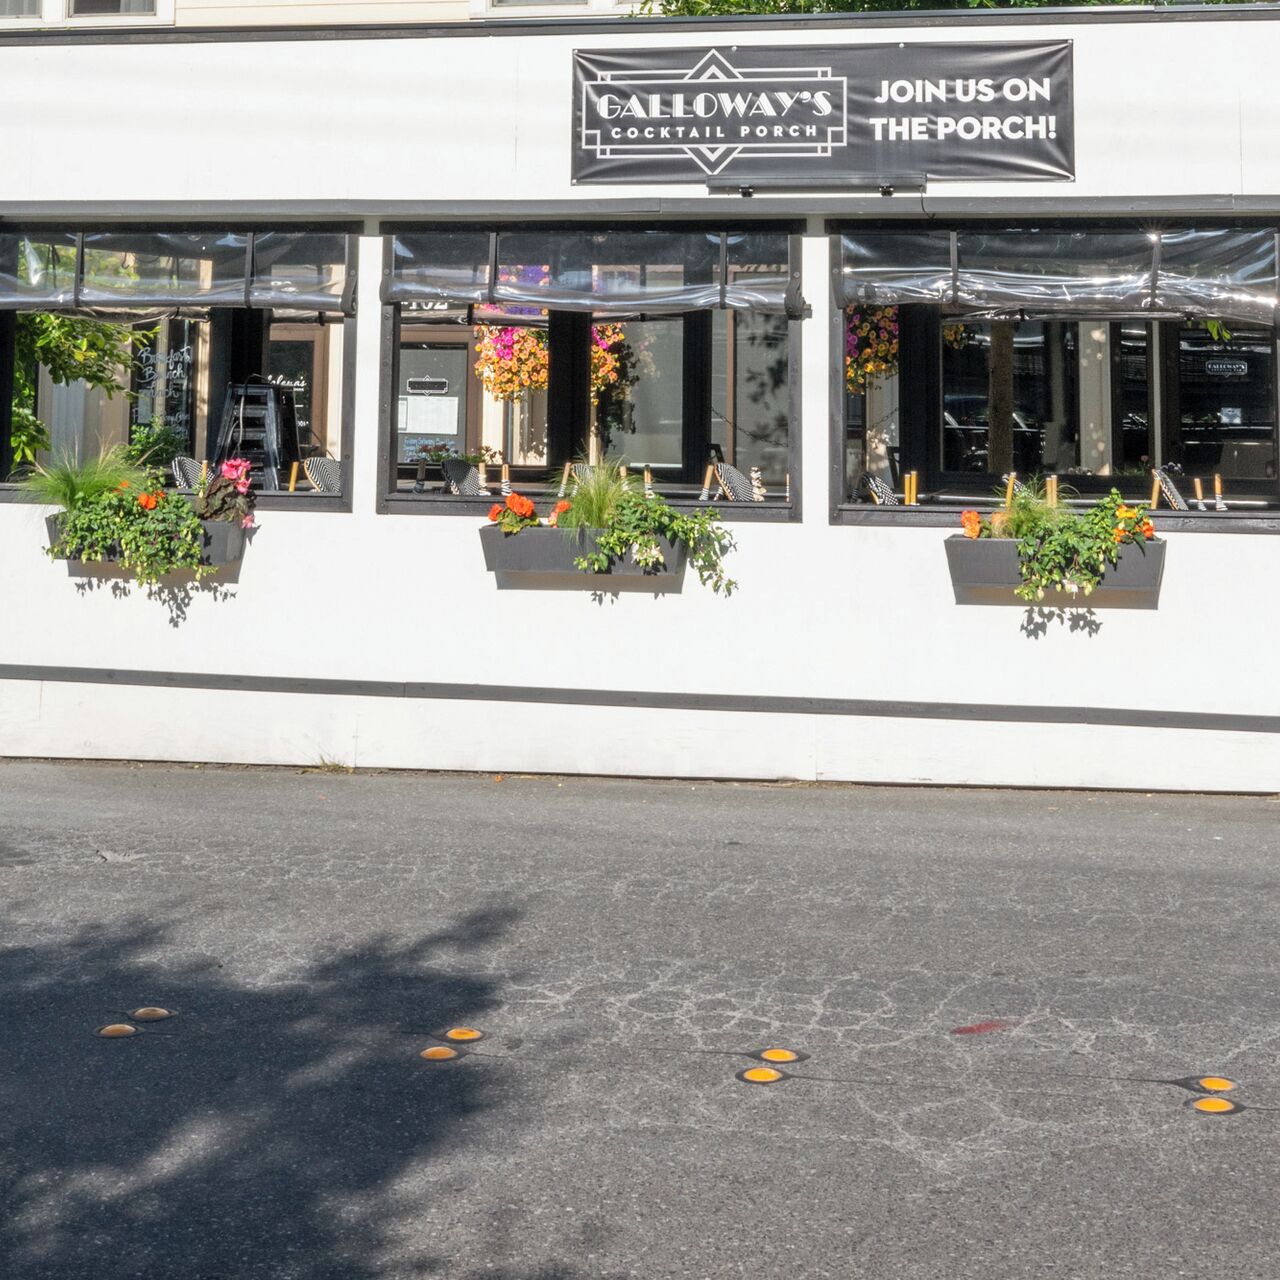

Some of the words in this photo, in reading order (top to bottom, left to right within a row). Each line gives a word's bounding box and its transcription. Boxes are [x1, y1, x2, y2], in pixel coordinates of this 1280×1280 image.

[873, 78, 948, 103] JOIN
[955, 78, 995, 102] US
[1001, 77, 1052, 102] ON
[596, 89, 833, 120] GALLOWAY'S
[611, 125, 726, 139] COCKTAIL
[741, 124, 818, 137] PORCH
[869, 117, 929, 141] THE
[937, 115, 1057, 141] PORCH!
